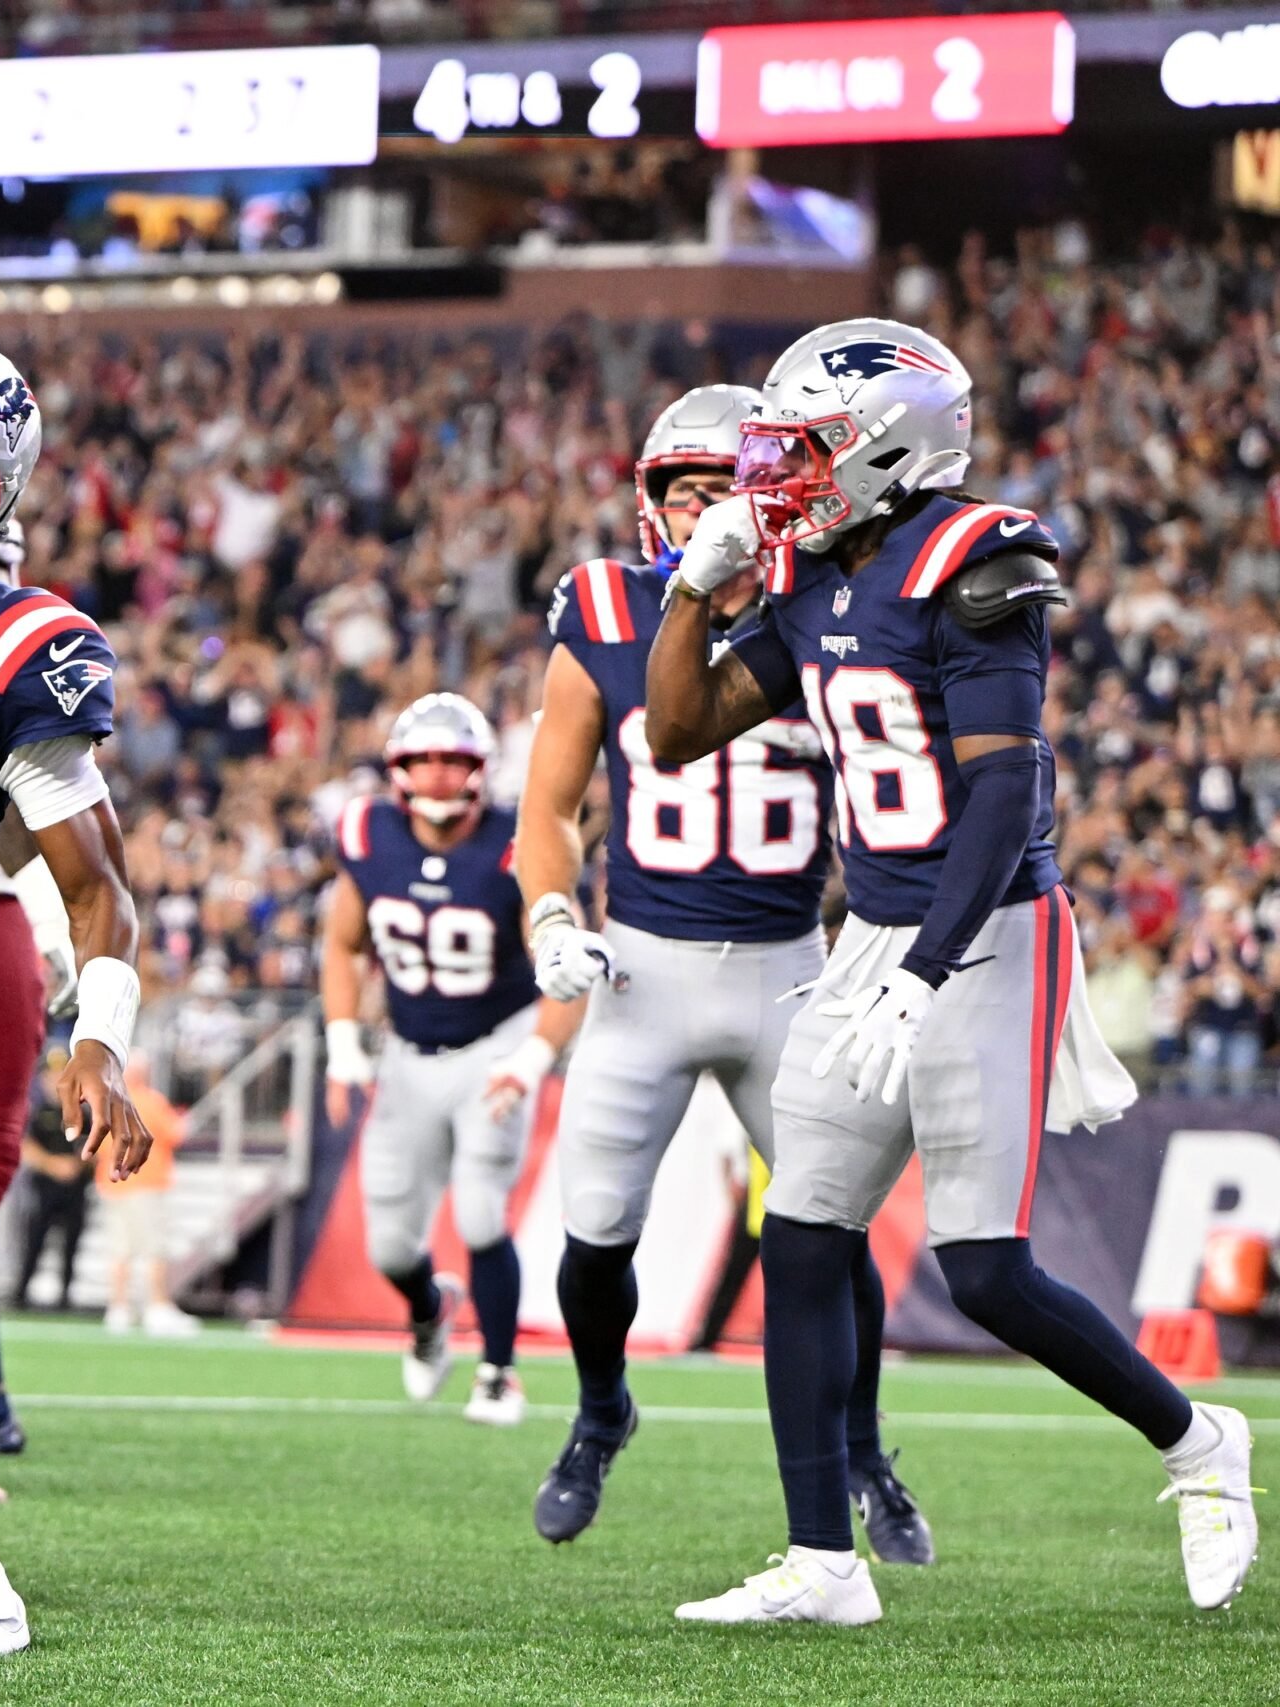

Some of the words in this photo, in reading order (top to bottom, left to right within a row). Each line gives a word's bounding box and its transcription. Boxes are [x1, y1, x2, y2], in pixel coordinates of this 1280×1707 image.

[586, 51, 642, 138] 2
[930, 36, 985, 123] 2
[619, 706, 823, 876] 86
[801, 663, 948, 850] 18
[367, 896, 496, 998] 69
